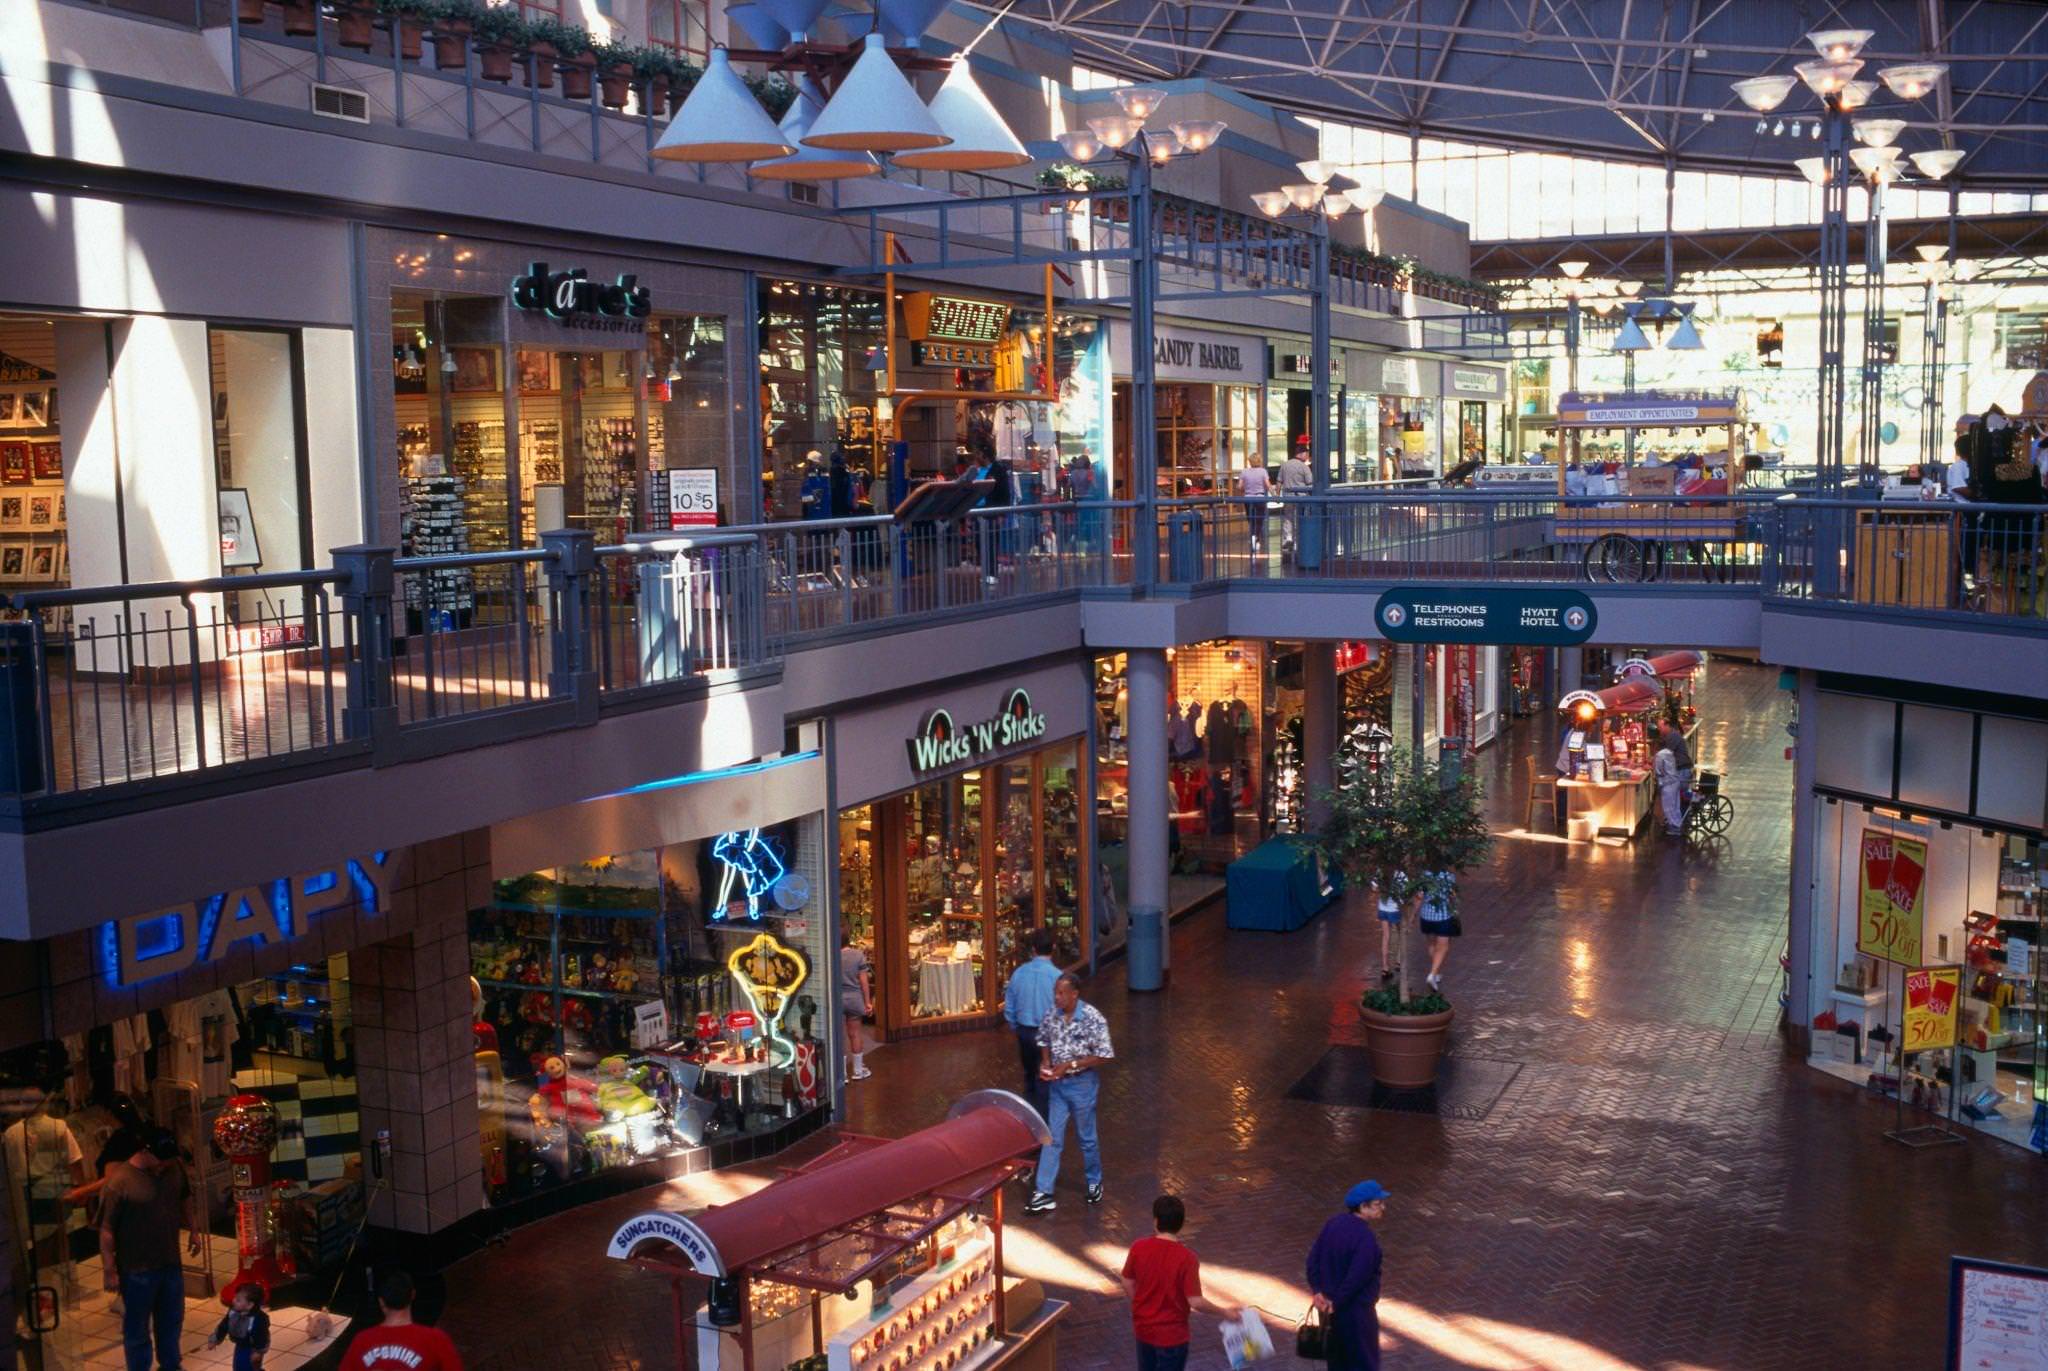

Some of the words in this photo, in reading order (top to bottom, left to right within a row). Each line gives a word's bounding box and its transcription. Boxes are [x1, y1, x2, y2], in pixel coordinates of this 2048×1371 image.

[563, 316, 643, 333] accessories
[930, 300, 1004, 340] SPORTS
[1199, 342, 1243, 370] BARREL
[1, 368, 39, 382] RAMS
[1590, 410, 1637, 419] EMPLOYMENT
[1640, 408, 1694, 418] OPPORTUNITIES
[673, 493, 693, 510] 10
[1412, 604, 1487, 615] TELEPHONES
[1521, 607, 1558, 617] HYATT
[1414, 617, 1485, 627] RESTROOMS
[1520, 617, 1559, 627] HOTEL
[915, 726, 971, 771] Wicks
[1001, 706, 1046, 746] Sticks
[1866, 846, 1892, 860] SALE
[1887, 889, 1913, 912] SALE
[104, 849, 401, 986] DAPY
[1908, 975, 1930, 992] SALE
[1928, 999, 1950, 1016] SALE
[616, 1220, 706, 1262] SUNCATCHERS
